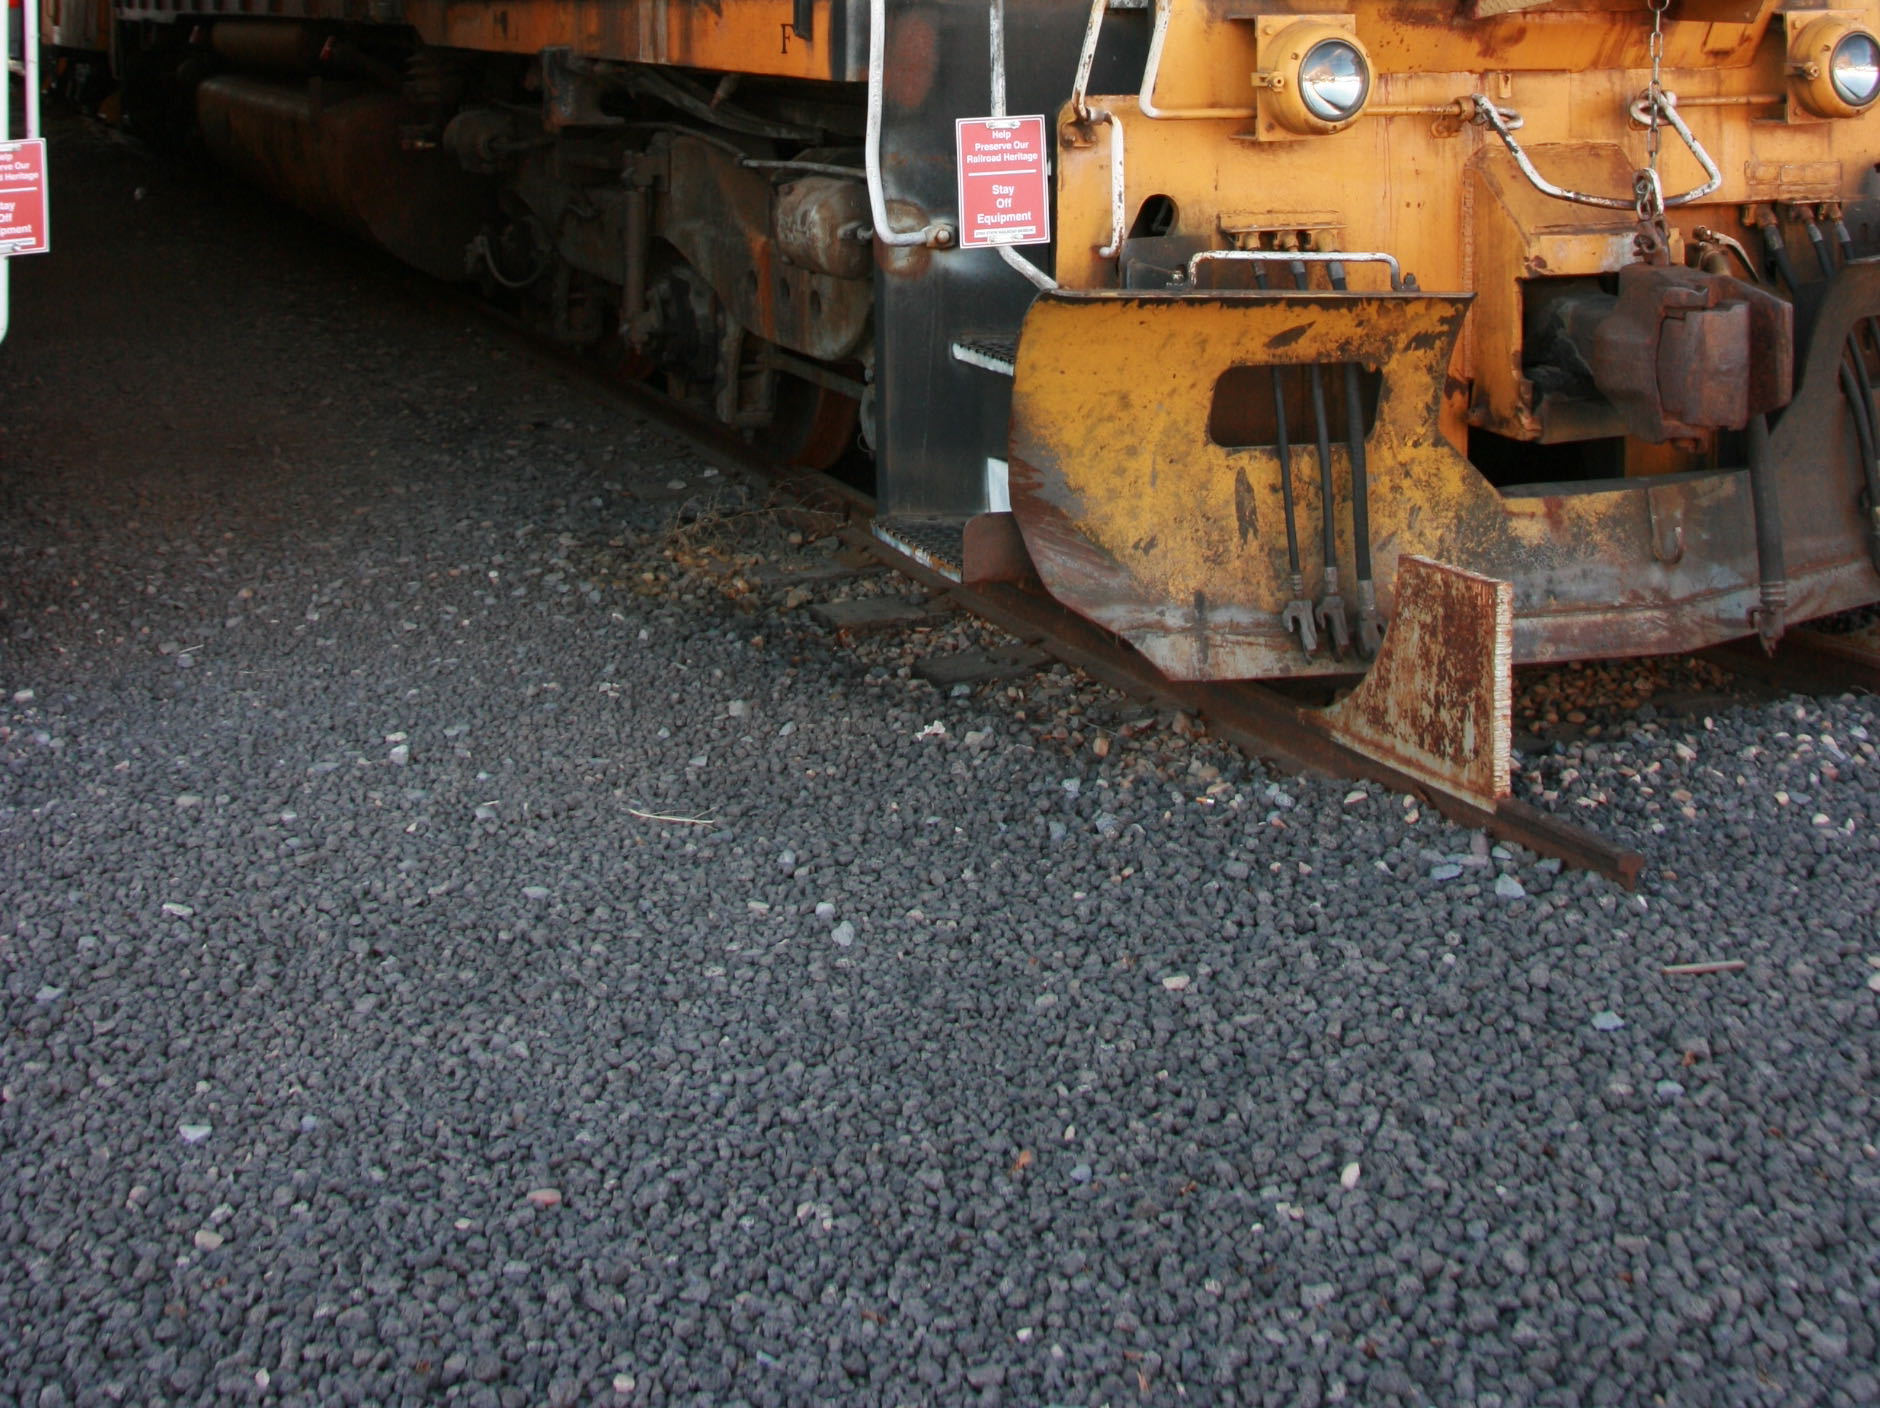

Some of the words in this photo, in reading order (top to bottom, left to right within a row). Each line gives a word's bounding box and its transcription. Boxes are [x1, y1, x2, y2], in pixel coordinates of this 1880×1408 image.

[992, 130, 1012, 140] Help
[974, 142, 1012, 152] Preserve
[1014, 142, 1028, 150] Our
[966, 154, 1002, 164] Railroad
[1004, 152, 1038, 162] Heritage
[992, 184, 1014, 196] Stay
[996, 198, 1012, 208] Off
[976, 210, 1032, 226] Equipment
